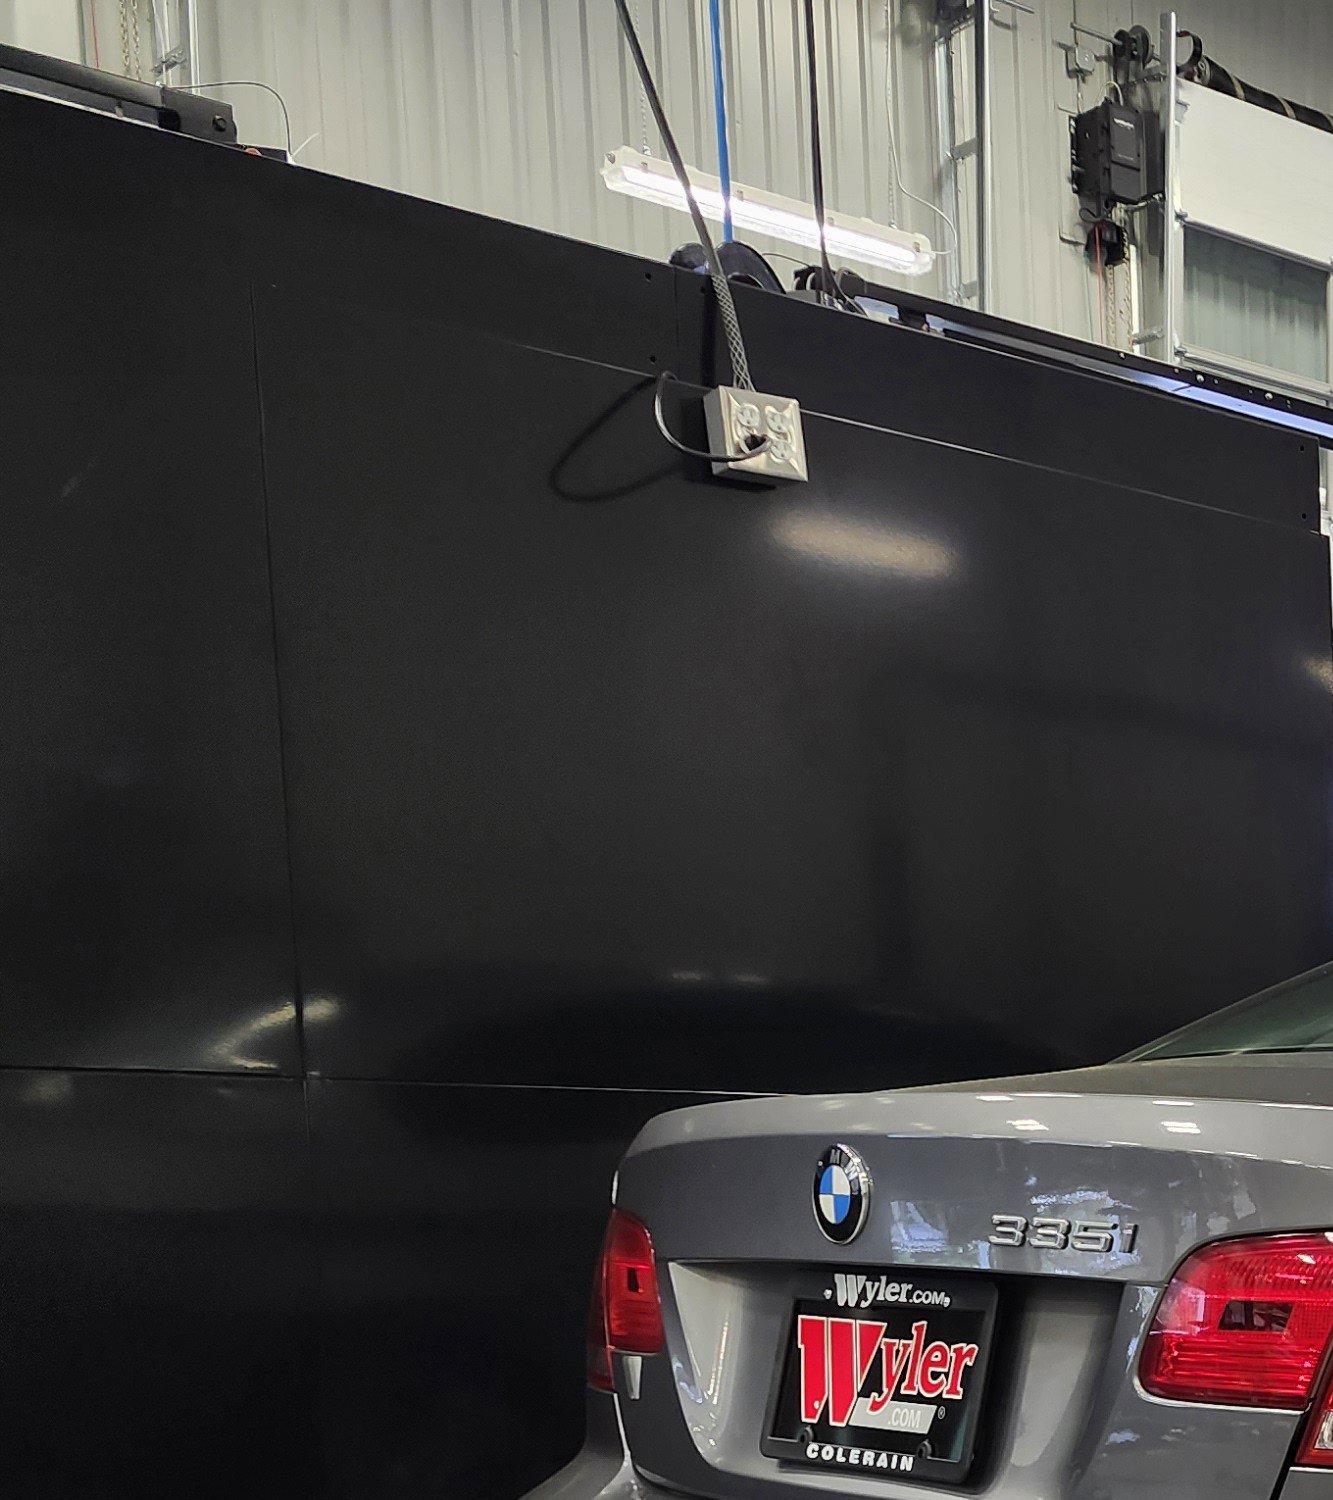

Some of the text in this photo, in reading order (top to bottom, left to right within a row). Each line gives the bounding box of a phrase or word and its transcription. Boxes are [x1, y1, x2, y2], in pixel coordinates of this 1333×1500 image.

[988, 1213, 1140, 1254] 335i
[797, 1314, 979, 1428] Wyler
[805, 1442, 915, 1472] COLERAIN
